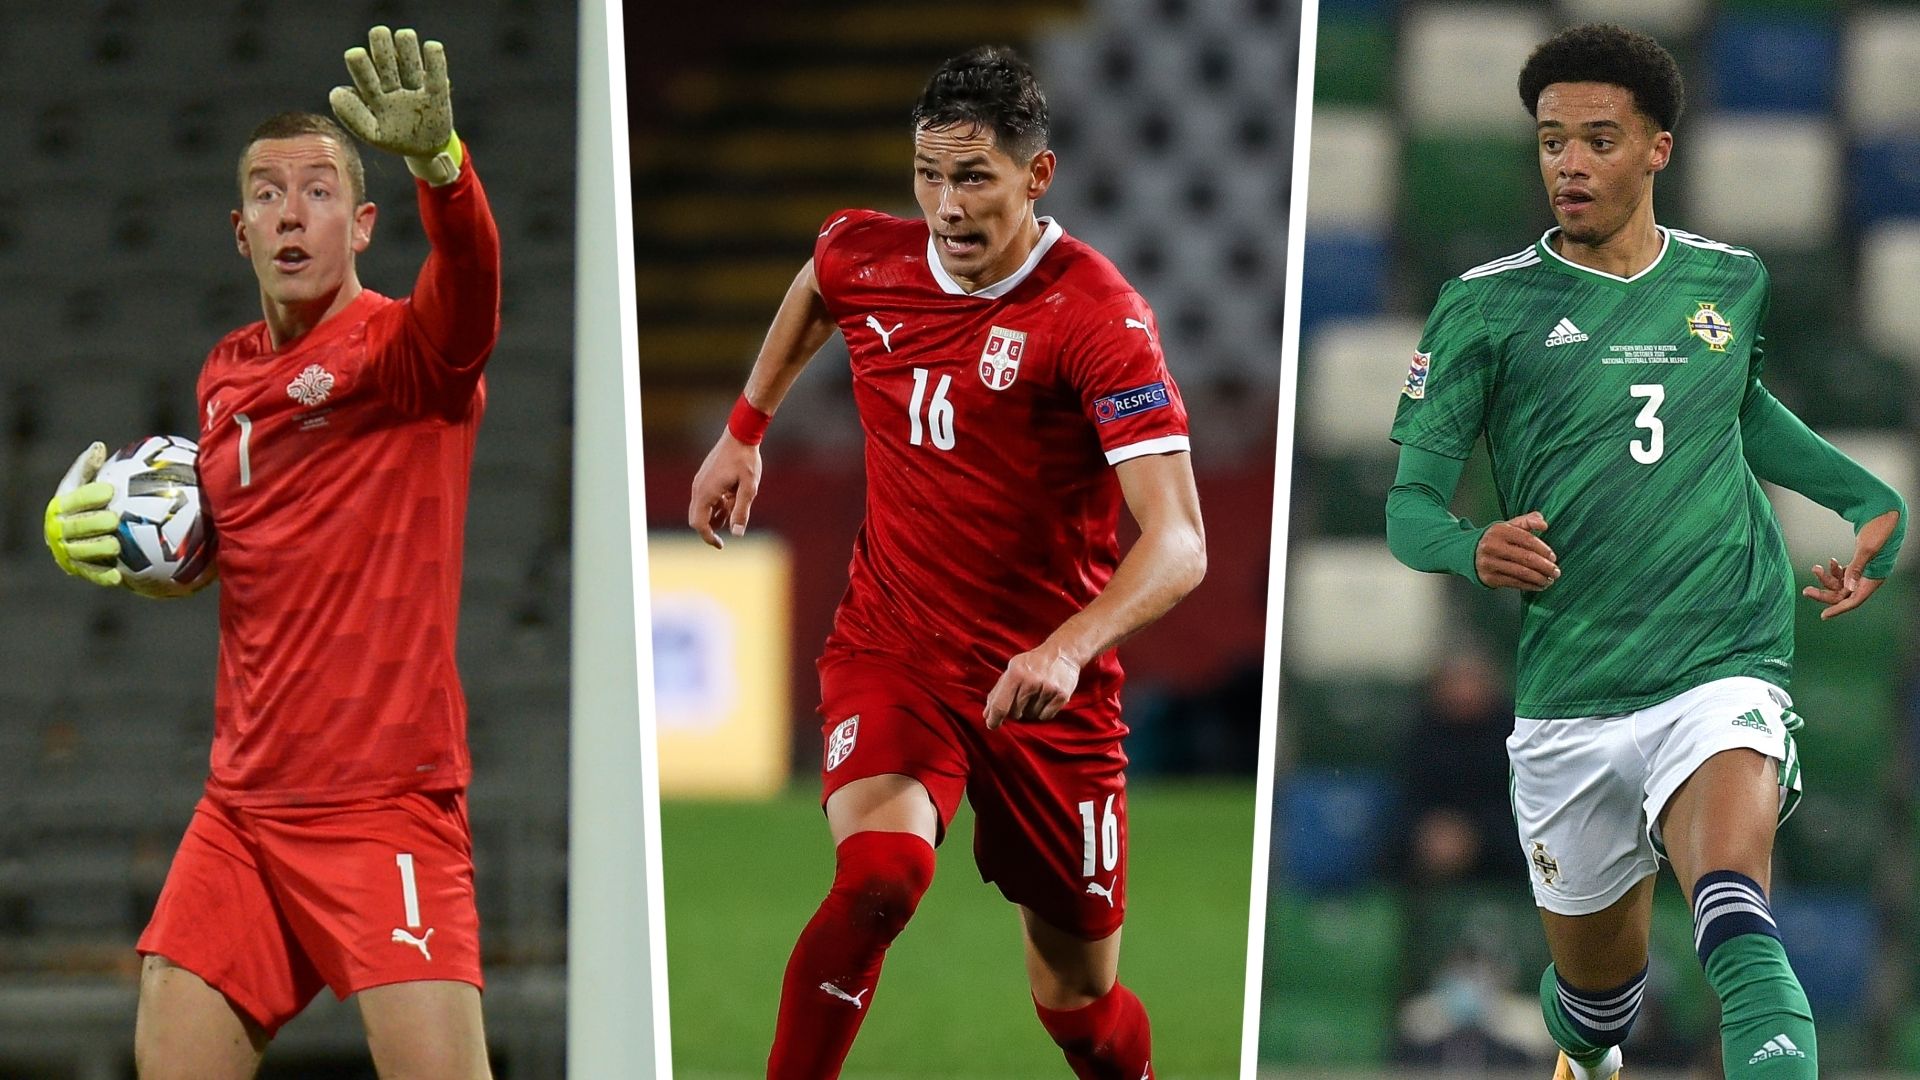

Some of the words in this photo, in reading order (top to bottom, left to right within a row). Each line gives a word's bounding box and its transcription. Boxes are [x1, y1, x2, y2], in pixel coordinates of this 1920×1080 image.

[1545, 333, 1589, 348] adidas
[908, 367, 956, 451] 16
[1115, 388, 1167, 411] RESPECT
[1629, 384, 1666, 465] 3
[233, 413, 252, 487] 1
[1078, 793, 1118, 877] 16
[396, 853, 421, 928] 1
